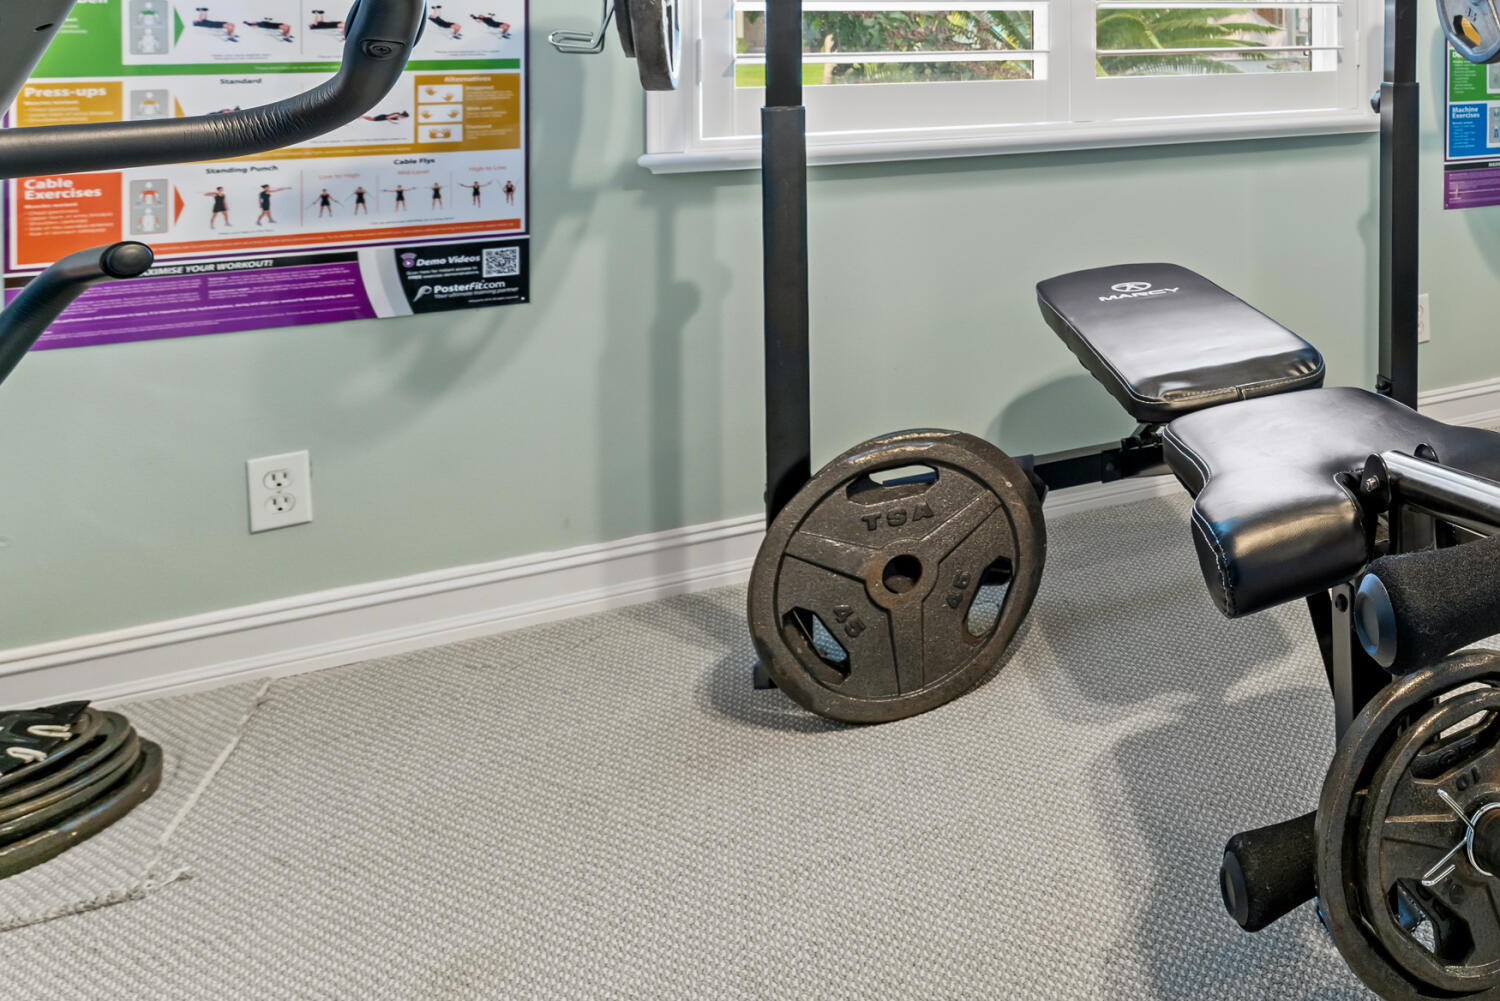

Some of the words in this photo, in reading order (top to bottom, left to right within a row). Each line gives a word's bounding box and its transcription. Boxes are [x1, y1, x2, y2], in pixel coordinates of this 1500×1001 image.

[444, 75, 491, 83] Alternatives
[24, 88, 107, 98] Press-ups
[205, 166, 248, 175] Standing
[250, 164, 278, 172] Punch
[24, 178, 74, 189] Cable
[24, 188, 102, 200] Exercises
[416, 258, 446, 266] Demo
[448, 255, 480, 263] Videos
[138, 266, 184, 277] AXIMISE
[185, 263, 215, 274] YOUR
[217, 259, 274, 271] WORKOUT!
[1099, 286, 1180, 302] MARCY
